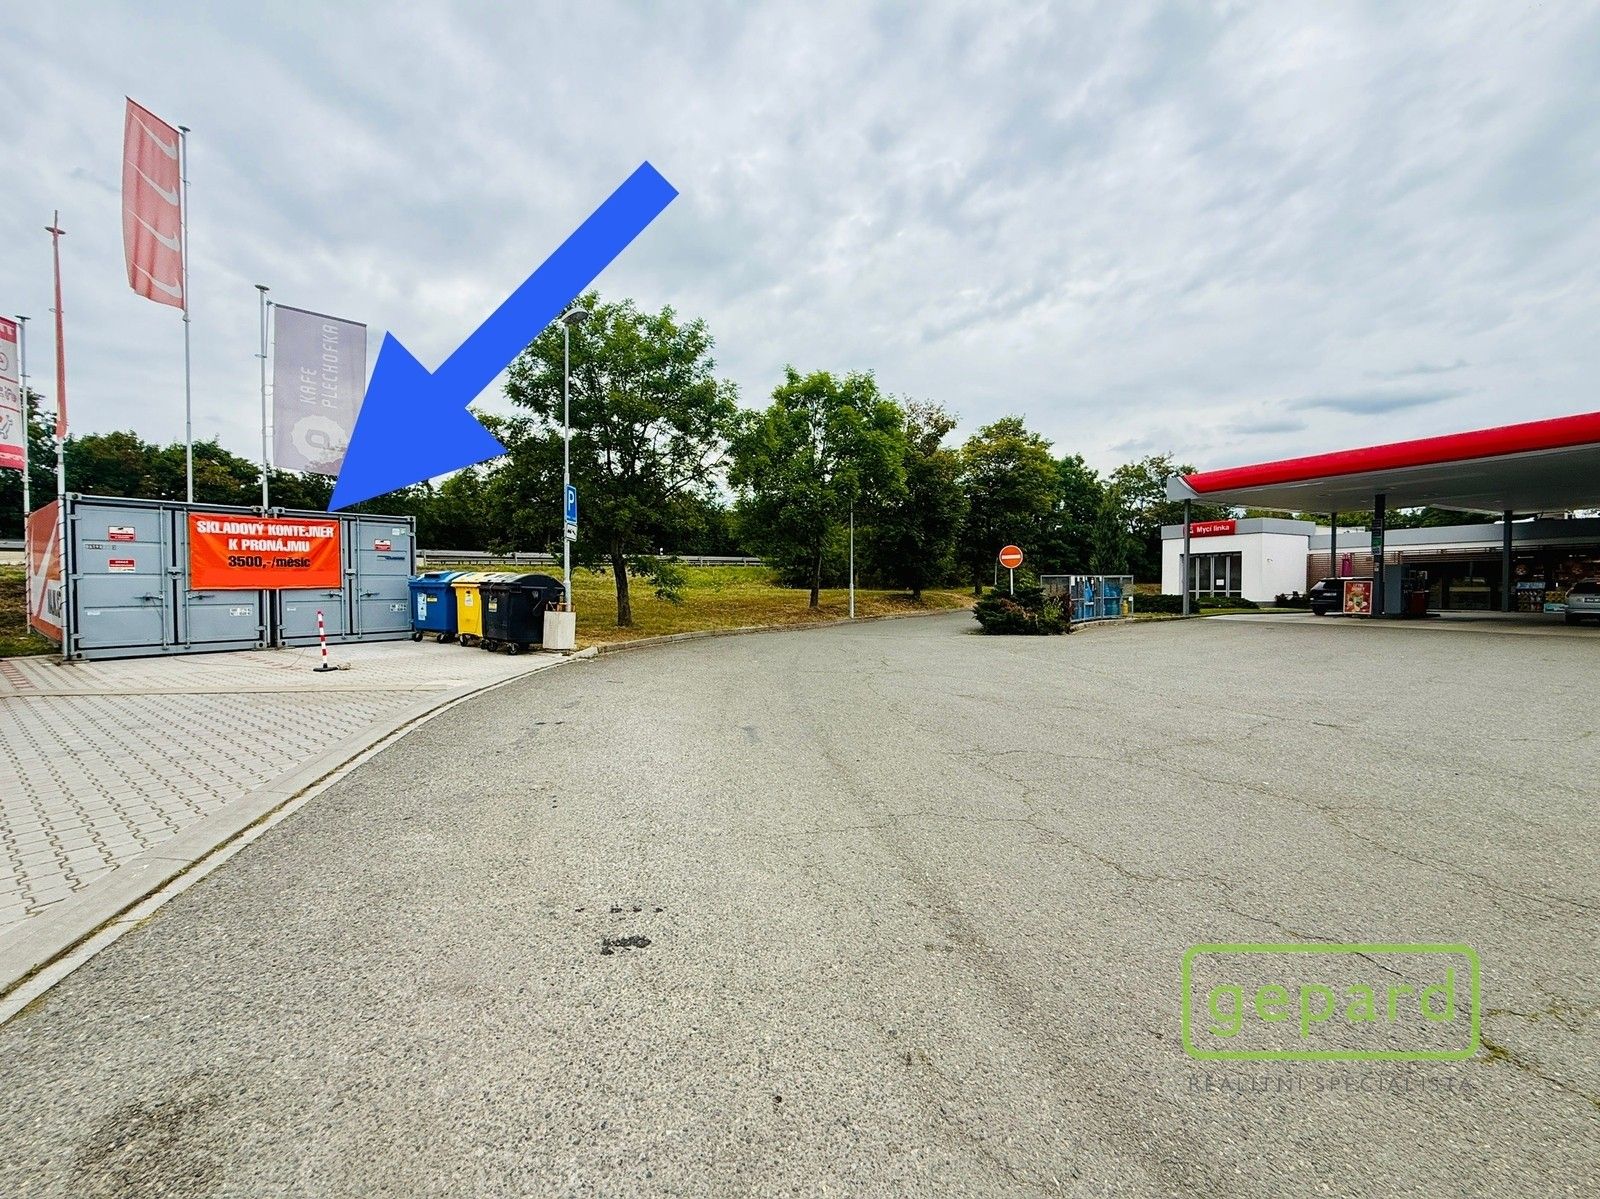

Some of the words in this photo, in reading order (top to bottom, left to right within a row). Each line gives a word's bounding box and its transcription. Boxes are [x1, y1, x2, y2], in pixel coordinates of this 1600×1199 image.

[321, 324, 339, 409] PLECHOFKA
[300, 367, 317, 404] KAFE
[568, 490, 574, 511] P
[197, 520, 264, 535] SKLADOVÝ
[268, 524, 334, 538] KONTEJNER
[1197, 526, 1212, 534] Mycí
[228, 538, 238, 551] K
[241, 538, 310, 552] PRONÁJMU
